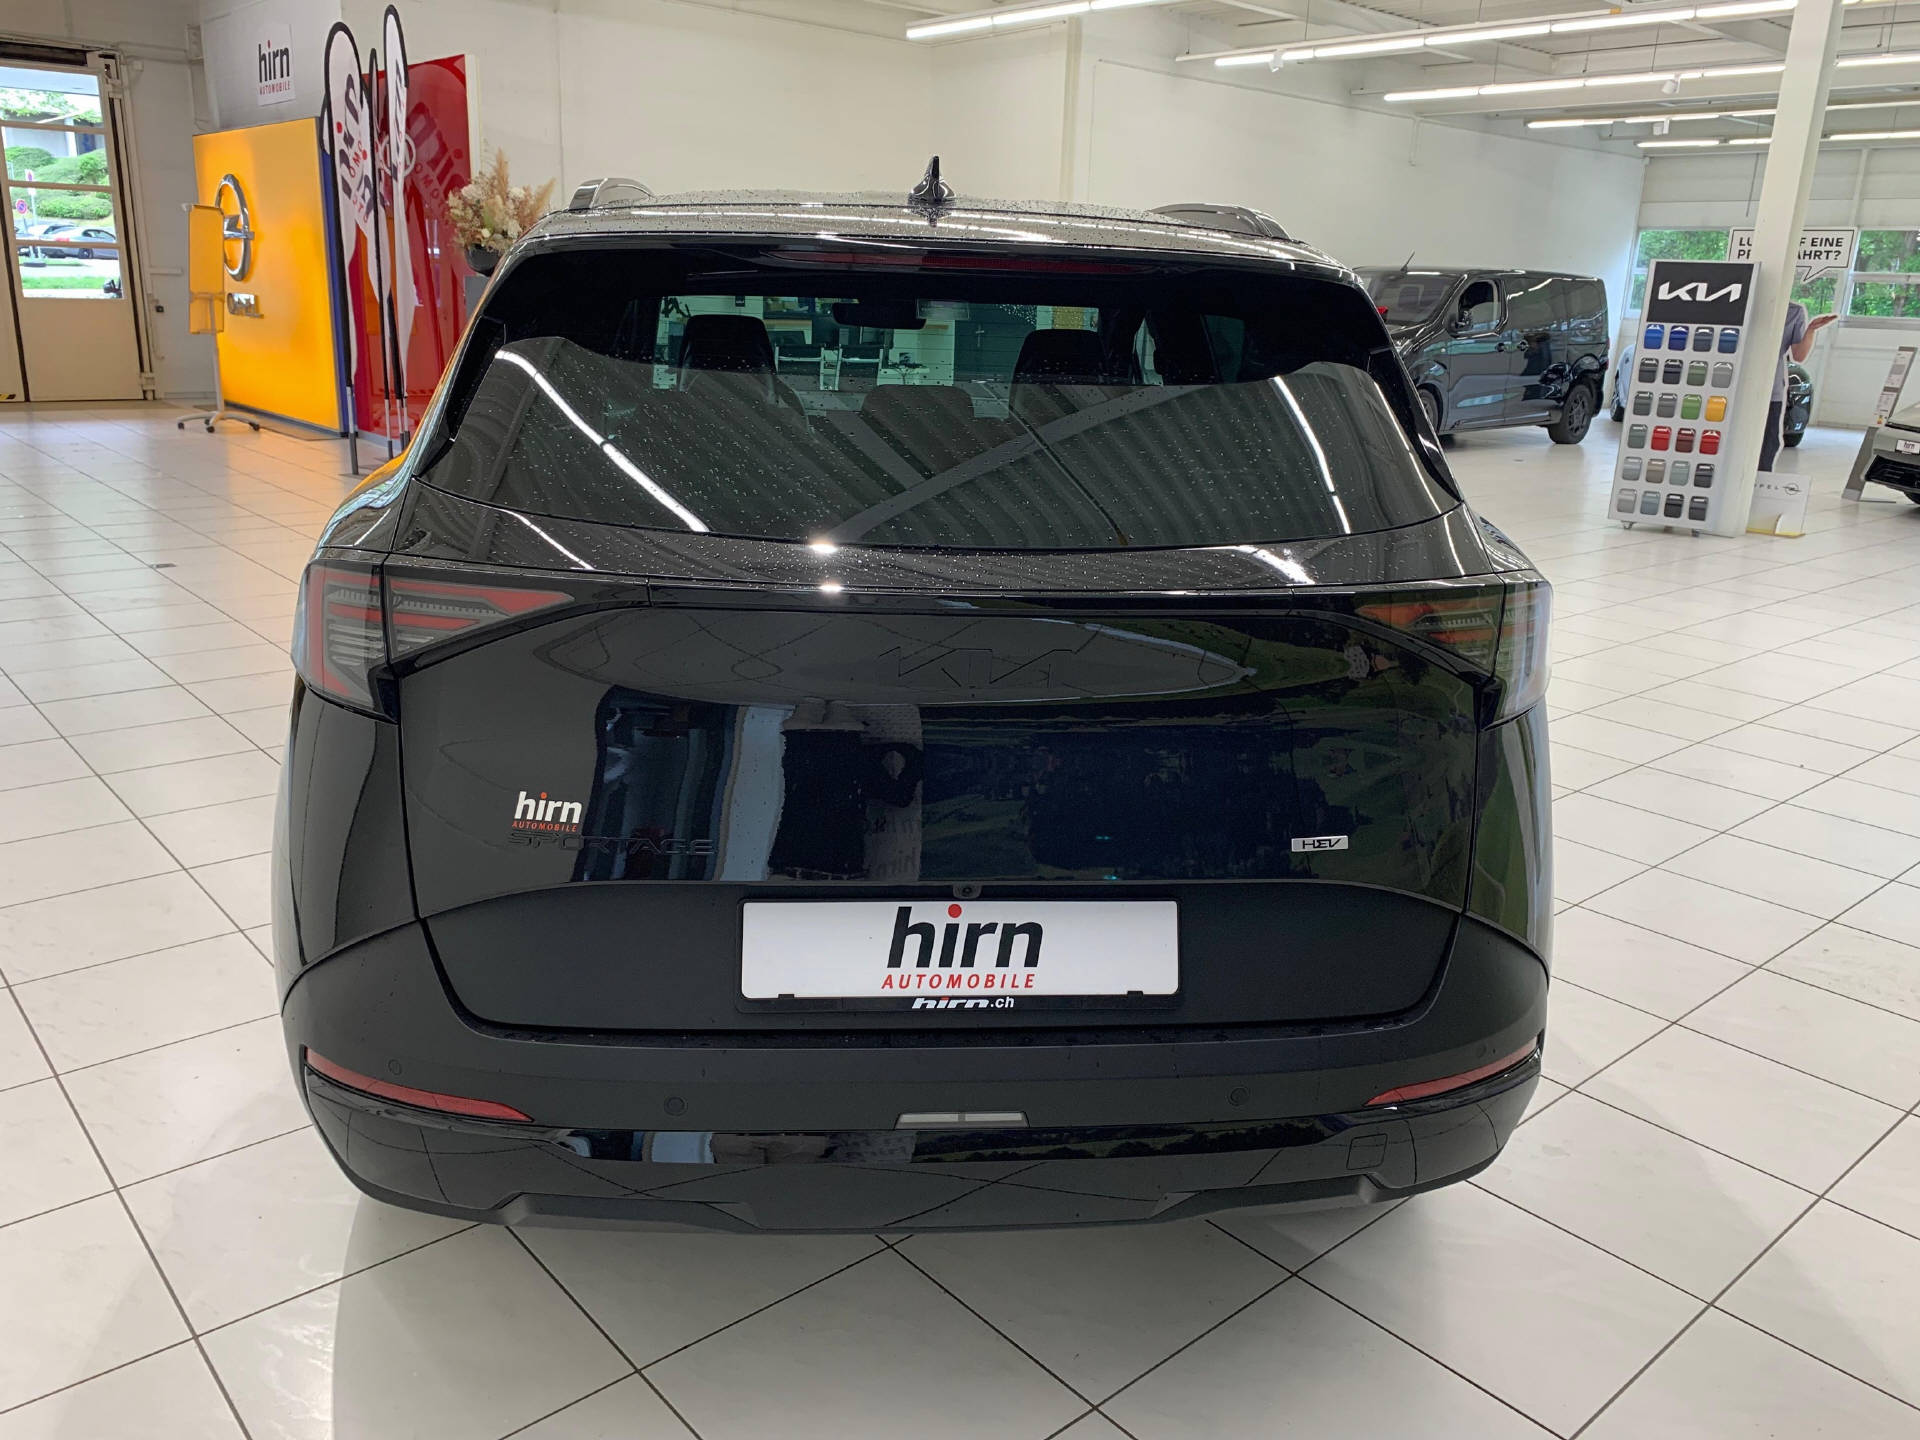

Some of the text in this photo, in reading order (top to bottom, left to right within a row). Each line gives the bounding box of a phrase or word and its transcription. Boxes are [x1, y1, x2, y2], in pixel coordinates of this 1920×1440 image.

[259, 40, 290, 83] hirn
[1811, 237, 1844, 247] EINE
[1658, 281, 1742, 302] KIA
[514, 791, 583, 823] hirn
[511, 821, 578, 832] AUTOMOBILE
[508, 831, 716, 855] SPORTAGE
[1302, 838, 1341, 849] HEV
[887, 904, 1043, 968] hirn
[881, 974, 1035, 989] AUTOMOBILE
[912, 996, 1015, 1009] hirn.ch
